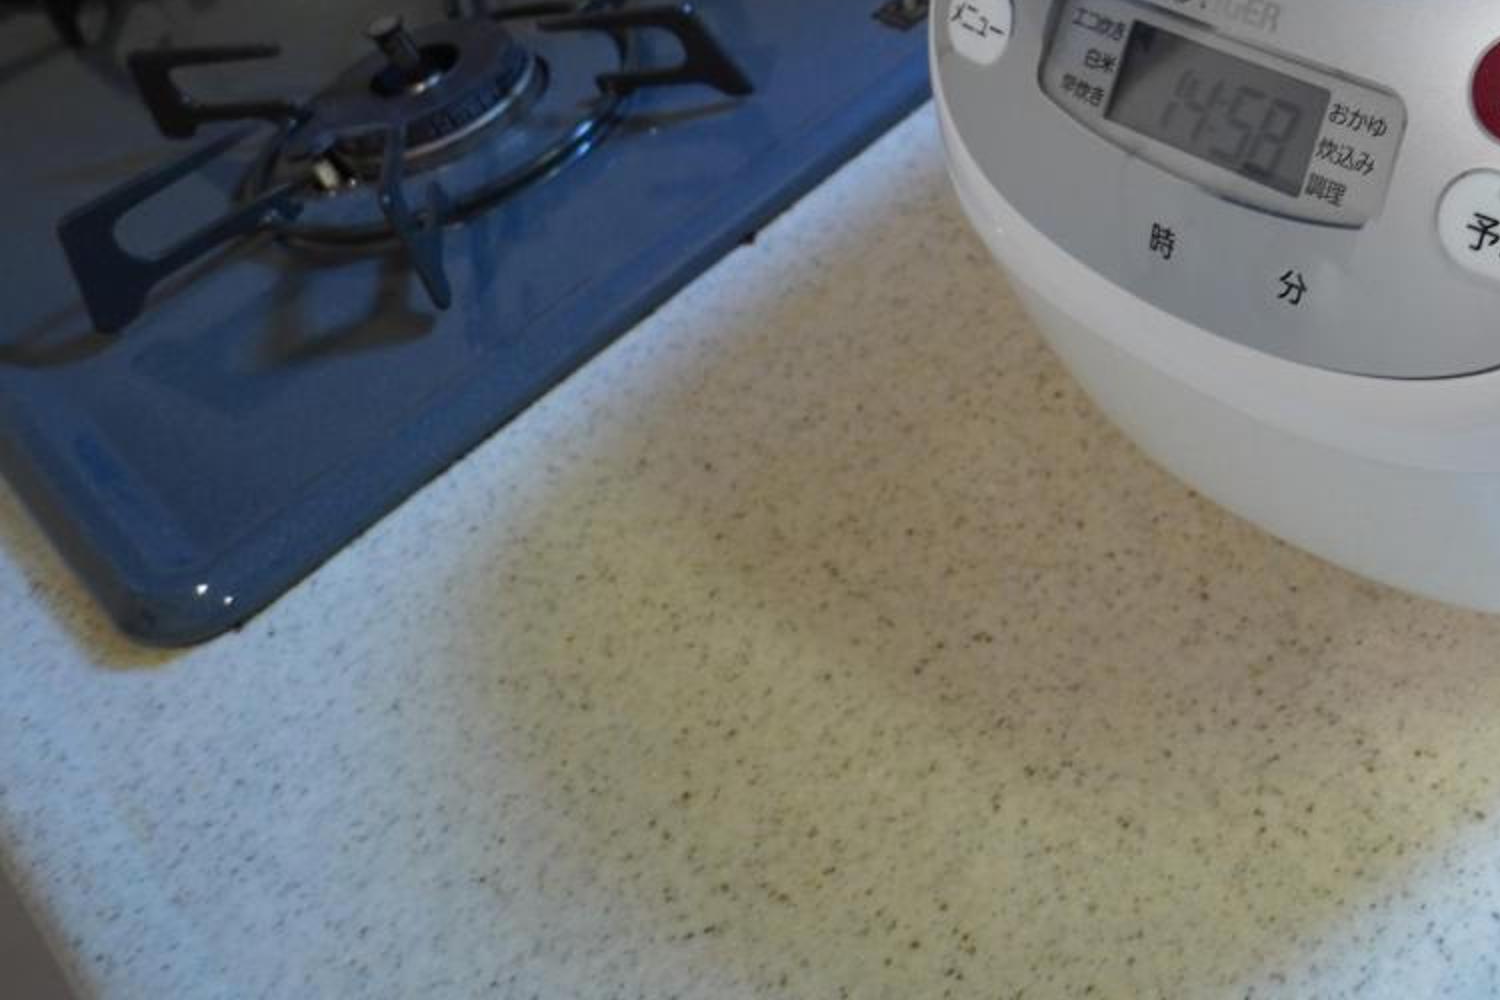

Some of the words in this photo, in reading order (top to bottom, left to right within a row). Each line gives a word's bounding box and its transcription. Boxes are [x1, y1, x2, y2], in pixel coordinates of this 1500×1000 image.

[951, 2, 1005, 38] メニュー
[1071, 6, 1126, 42] エコ炊き
[1084, 48, 1118, 73] 白米
[1328, 103, 1388, 137] おかゆ
[1315, 137, 1375, 176] 炊込み
[1304, 172, 1347, 207] 調理
[1149, 223, 1176, 260] 時
[1277, 269, 1307, 305] 分
